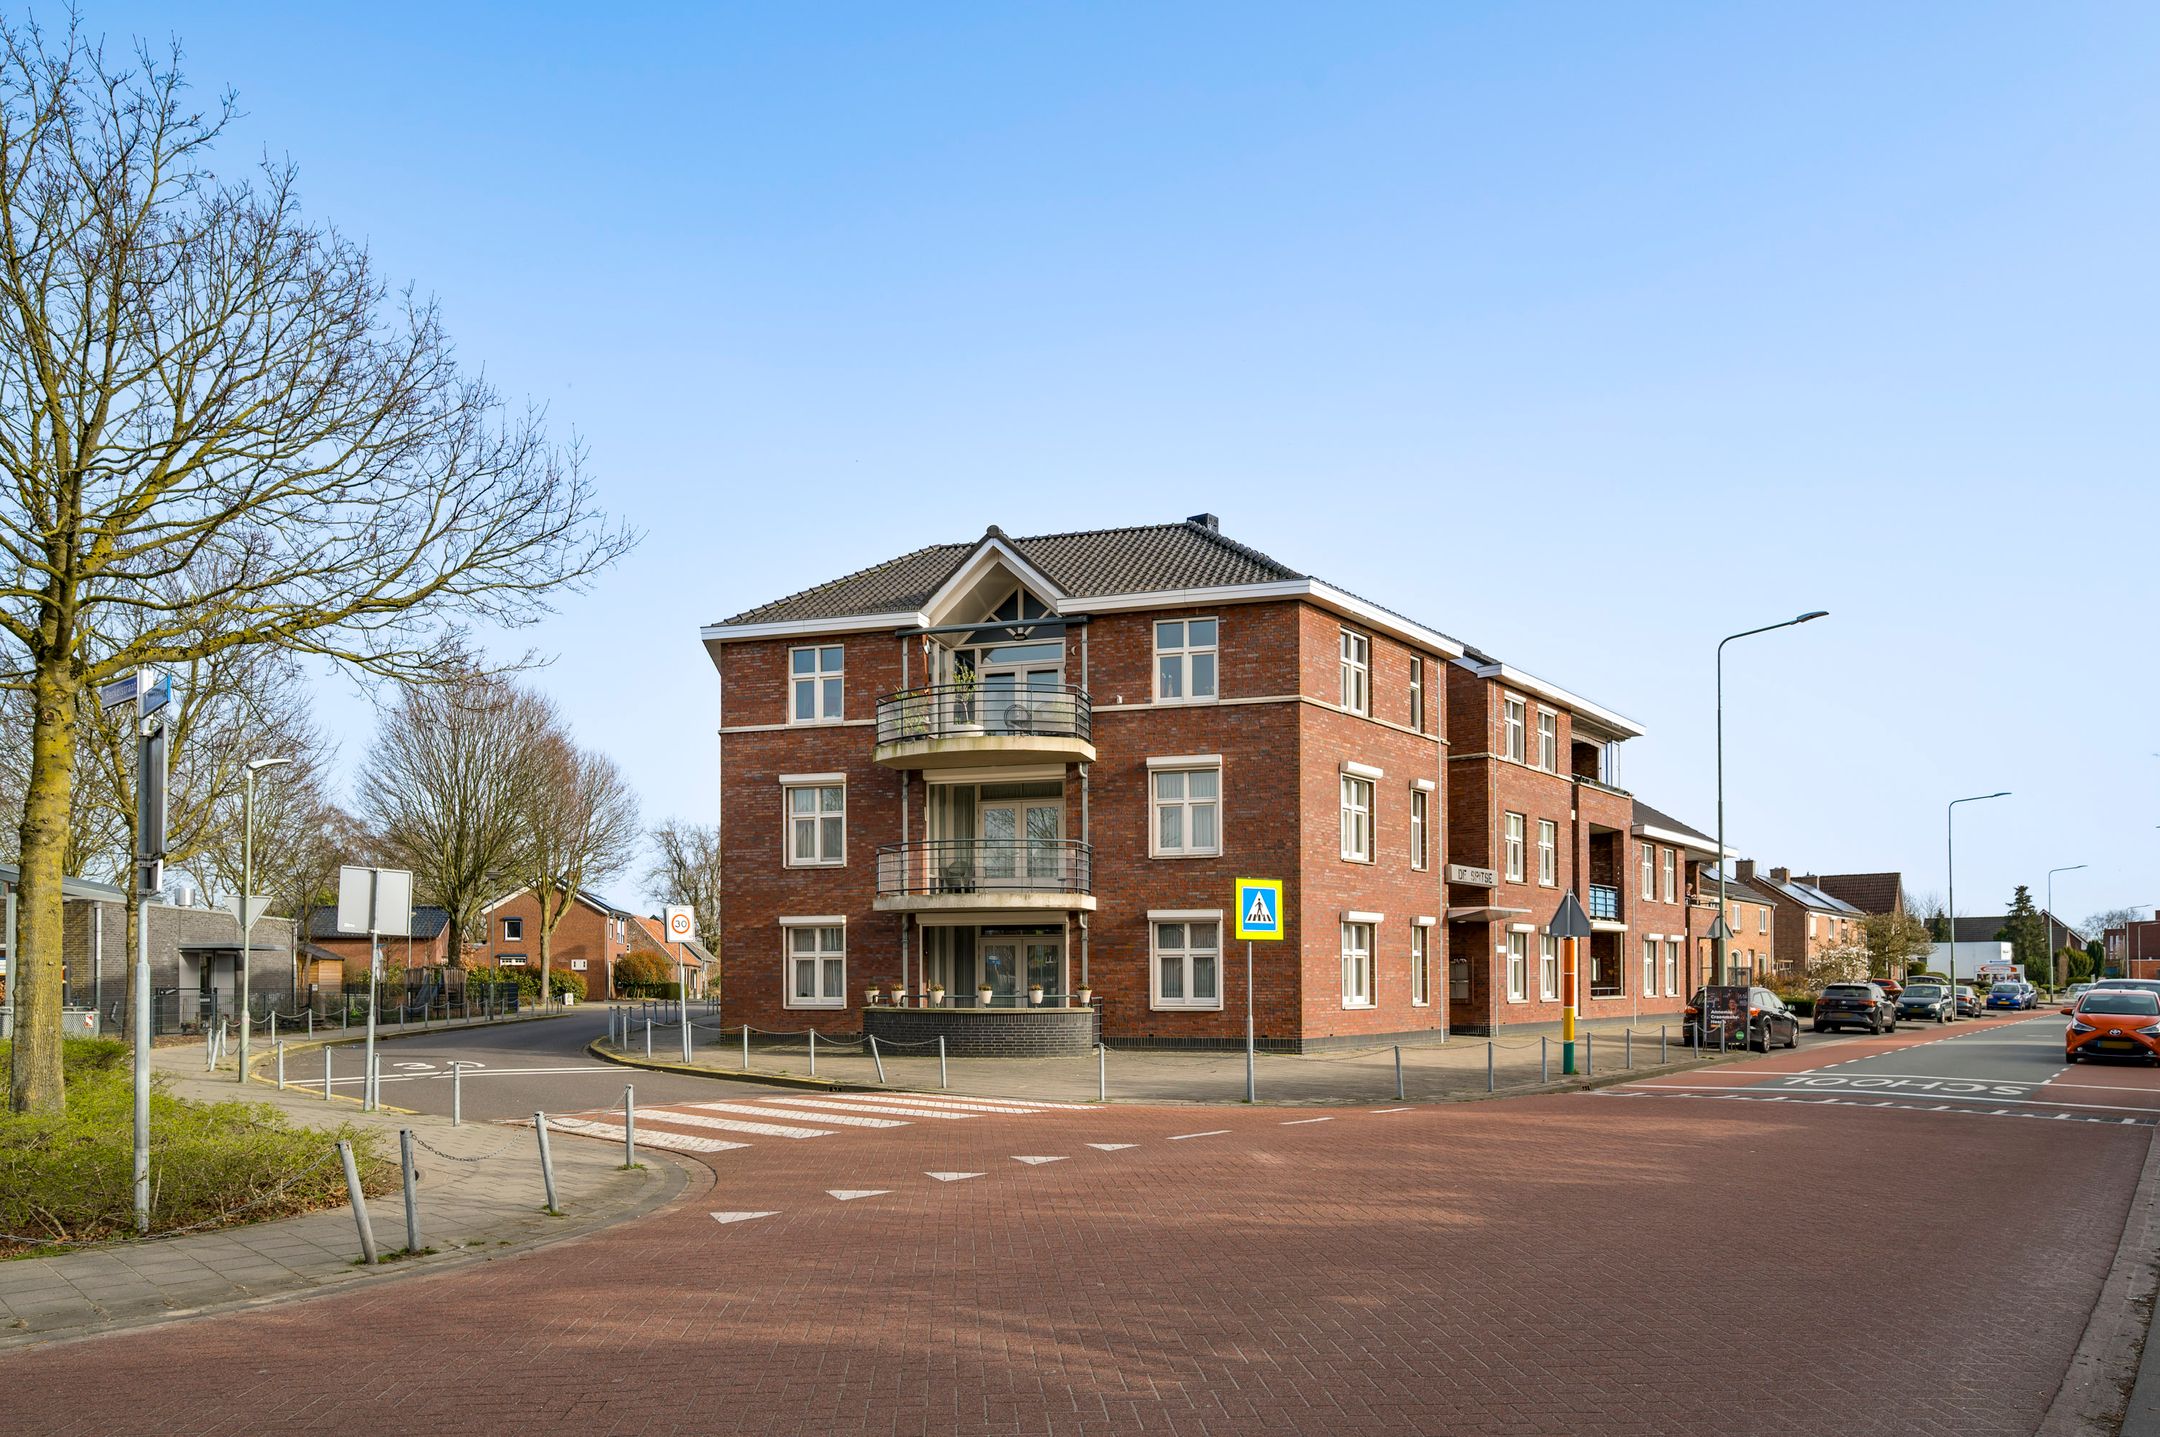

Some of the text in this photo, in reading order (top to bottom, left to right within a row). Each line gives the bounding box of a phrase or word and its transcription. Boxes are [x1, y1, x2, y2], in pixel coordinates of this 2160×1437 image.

[1458, 868, 1492, 883] DE SPITSE
[675, 920, 687, 928] 30
[1783, 1076, 2031, 1096] SCHOOL
